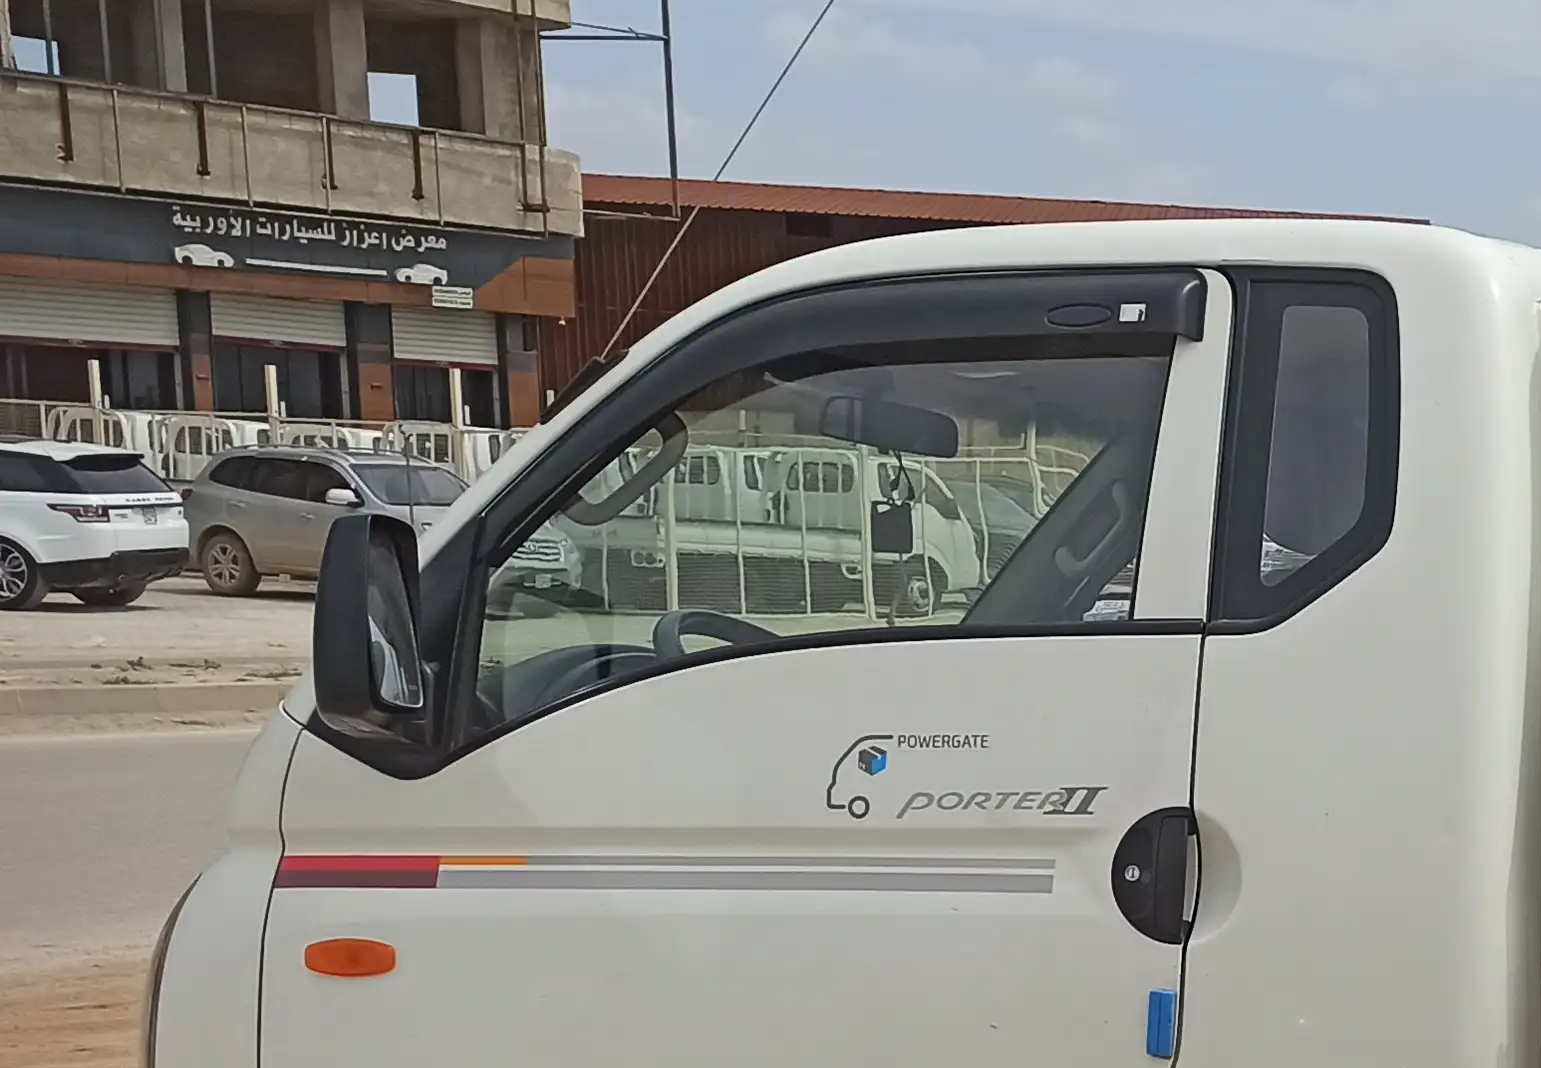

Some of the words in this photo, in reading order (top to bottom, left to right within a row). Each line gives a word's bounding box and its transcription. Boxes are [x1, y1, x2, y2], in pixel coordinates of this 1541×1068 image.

[256, 217, 336, 244] للسيارات
[391, 229, 447, 251] معرض
[897, 734, 989, 749] POWERGATE
